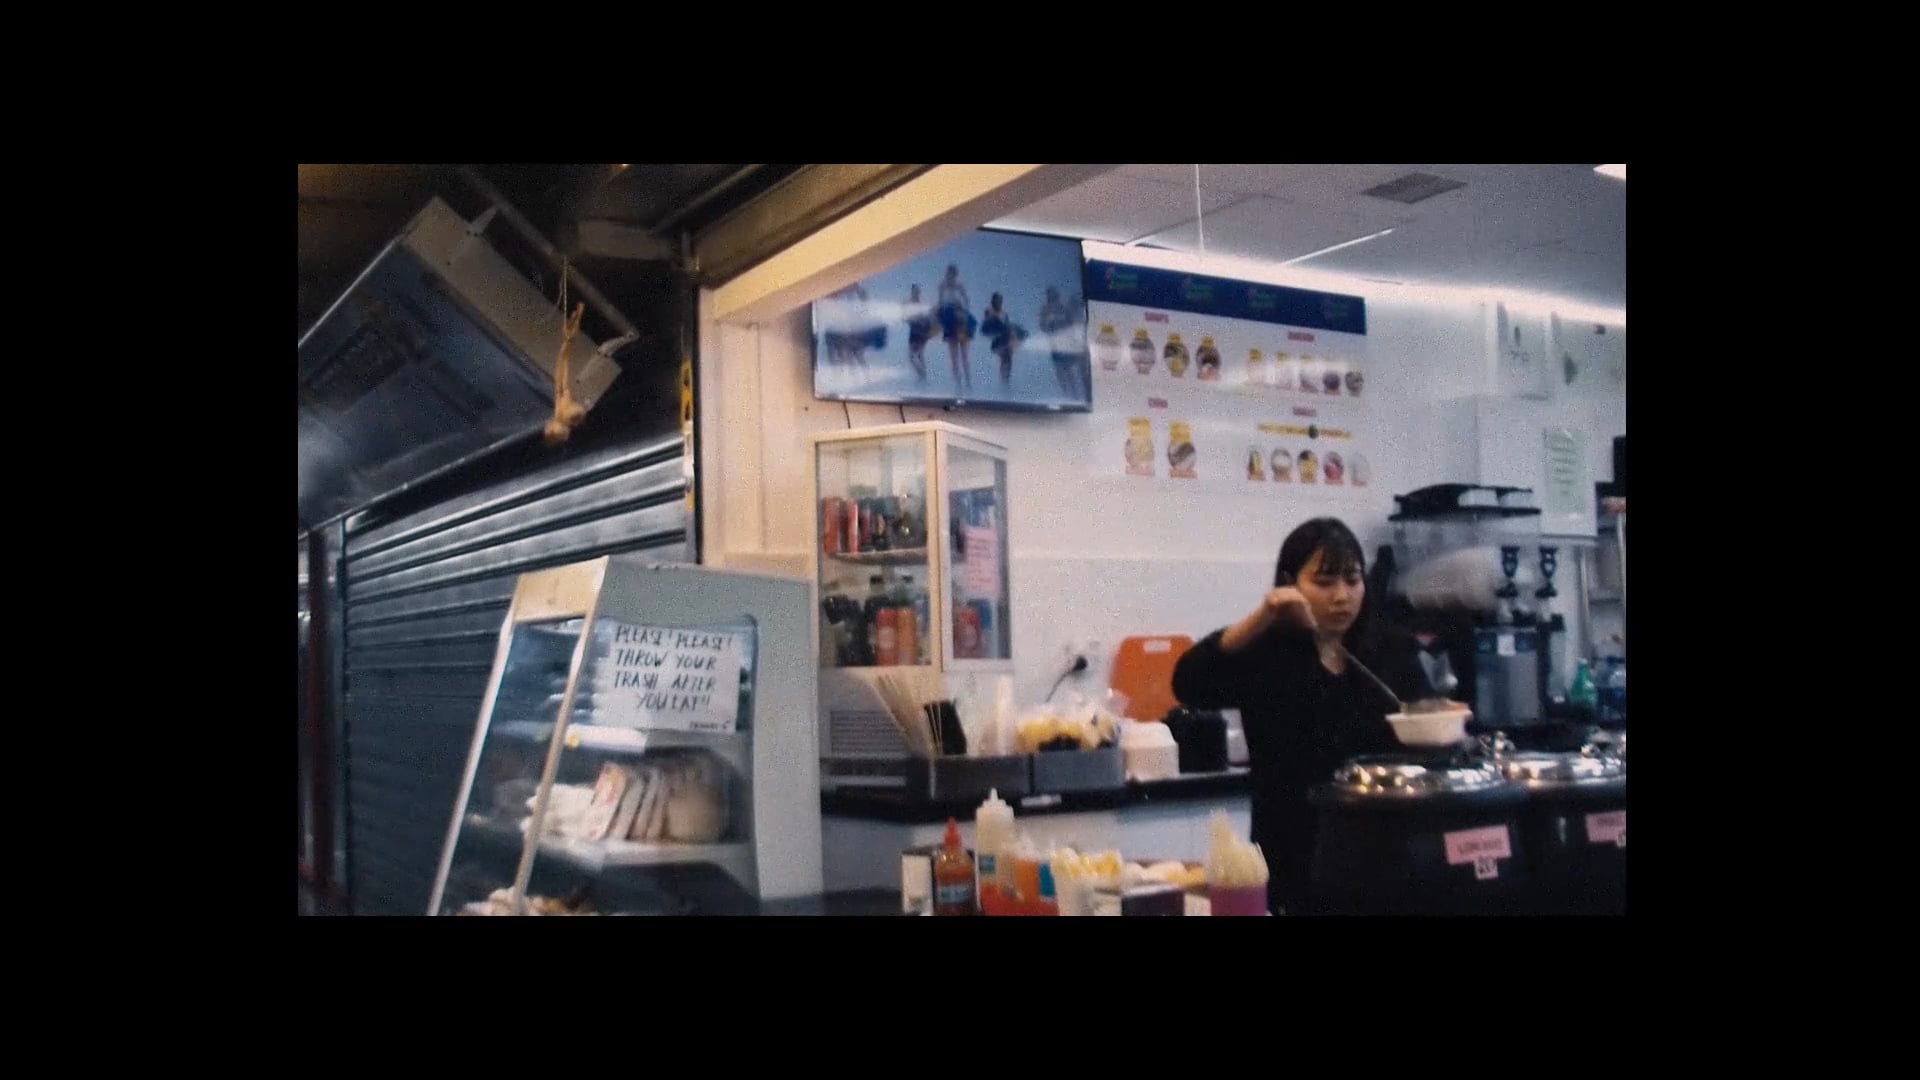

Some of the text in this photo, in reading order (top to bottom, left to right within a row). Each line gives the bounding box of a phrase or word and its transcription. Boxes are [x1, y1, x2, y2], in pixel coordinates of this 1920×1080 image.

[615, 648, 717, 671] THROW YOUR
[614, 670, 716, 691] TRASH AFTER
[636, 693, 668, 710] YOU
